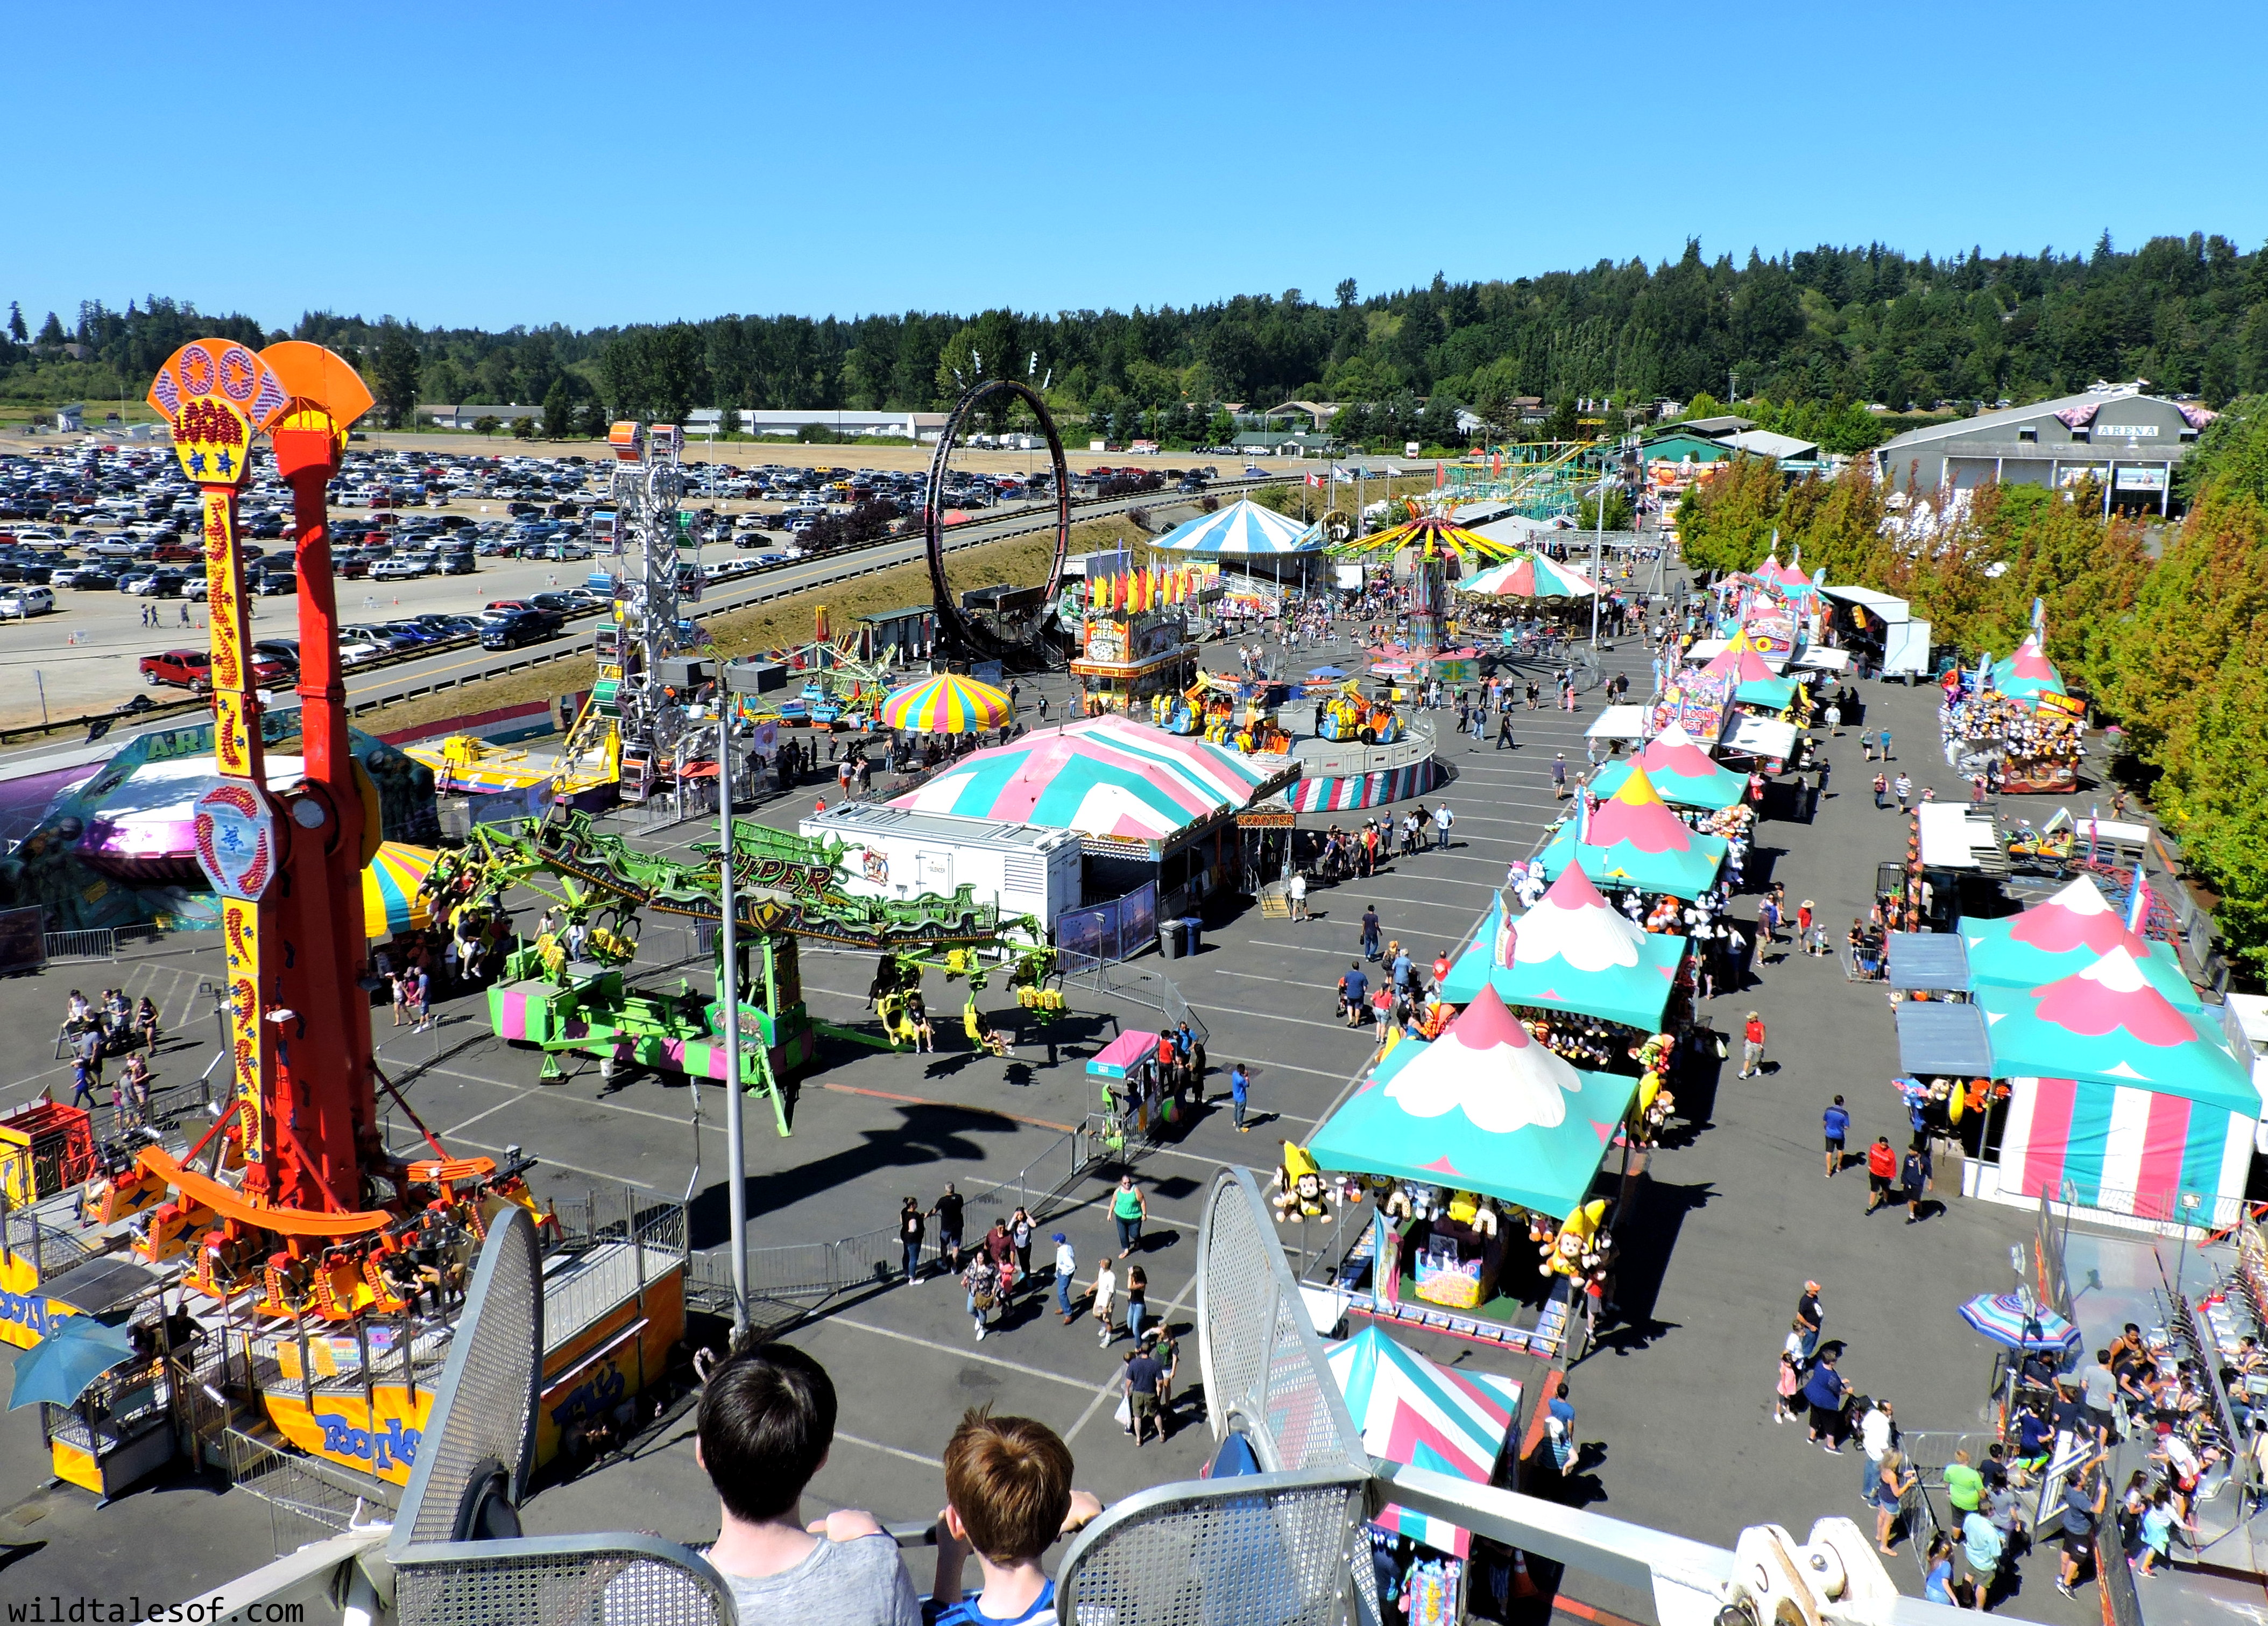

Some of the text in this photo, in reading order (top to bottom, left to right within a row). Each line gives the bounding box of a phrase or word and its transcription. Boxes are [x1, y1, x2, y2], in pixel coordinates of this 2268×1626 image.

[2100, 426, 2156, 435] ARENA
[1096, 618, 1114, 630] ICE
[1091, 629, 1122, 643] CREAM
[1666, 707, 1711, 721] BLOON
[1237, 814, 1295, 826] SCOOTER
[708, 843, 829, 906] VIPER
